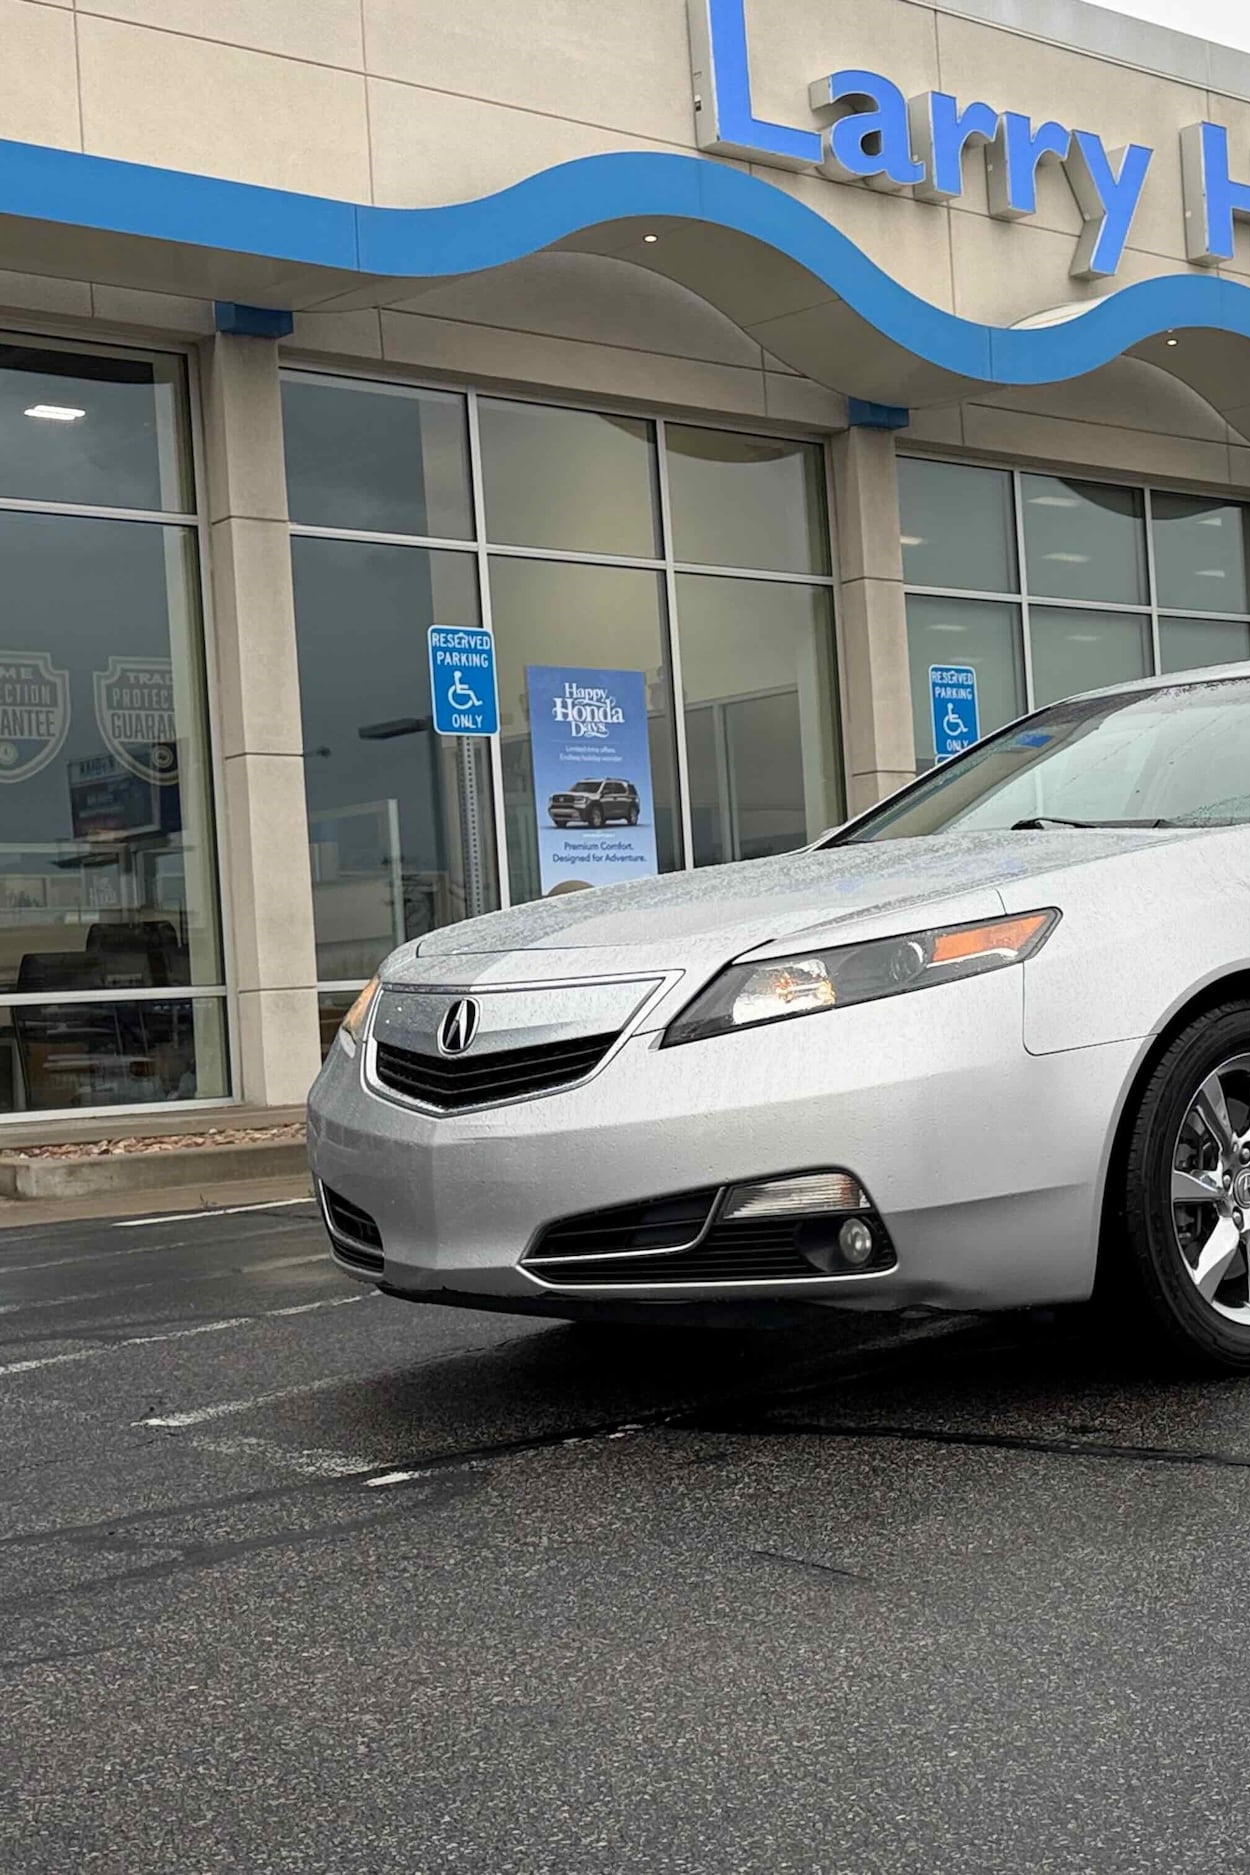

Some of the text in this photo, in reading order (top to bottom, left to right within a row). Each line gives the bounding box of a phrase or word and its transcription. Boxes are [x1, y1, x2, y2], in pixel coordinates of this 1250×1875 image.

[697, 0, 1154, 278] Larry
[431, 632, 491, 650] RESERVED
[436, 651, 489, 668] PARKING
[931, 670, 974, 685] RESERVED
[0, 683, 50, 706] CTION
[112, 687, 173, 709] PROTEC
[564, 682, 608, 704] Happy
[934, 686, 973, 701] PARKING
[552, 696, 625, 723] Honda
[451, 713, 483, 729] ONLY
[570, 721, 610, 738] Days
[563, 841, 599, 851] Premium
[552, 853, 591, 864] Designed
[592, 853, 604, 862] for
